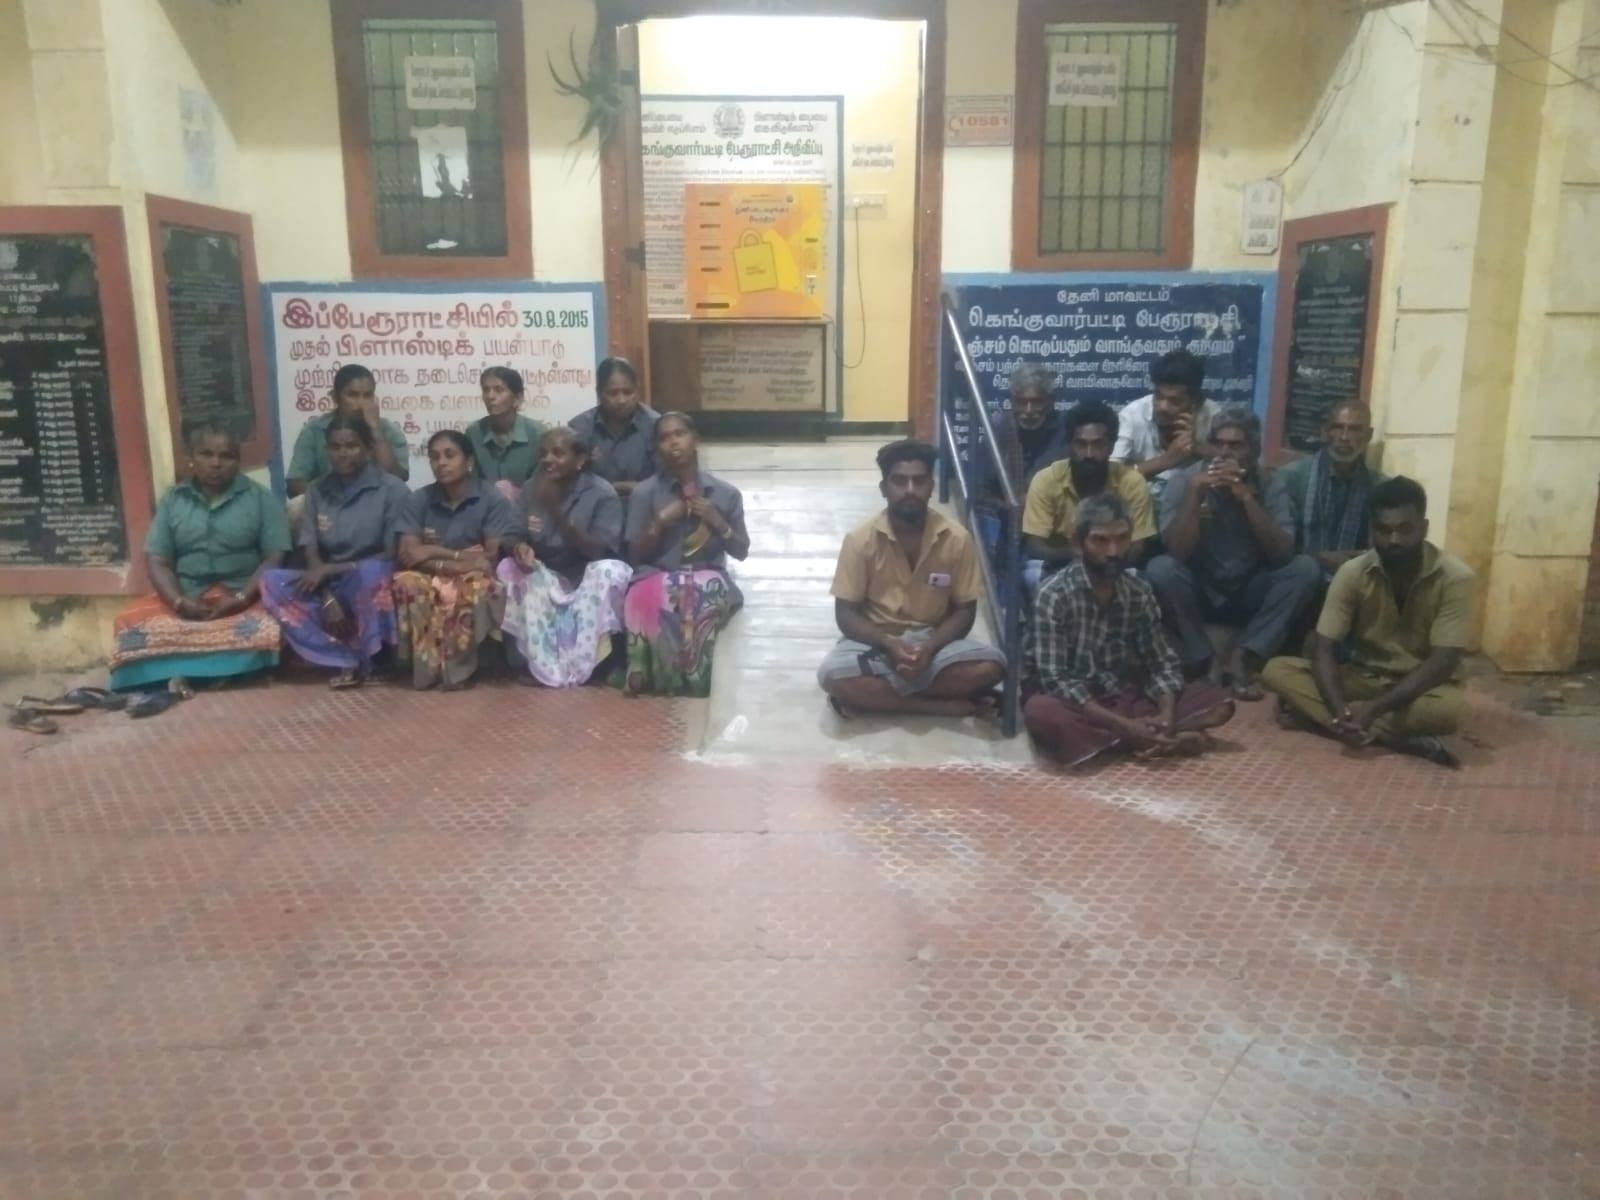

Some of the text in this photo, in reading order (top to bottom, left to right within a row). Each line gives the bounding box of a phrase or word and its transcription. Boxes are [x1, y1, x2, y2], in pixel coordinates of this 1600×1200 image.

[1057, 285, 1171, 304] தேனி மாவட்டம்
[969, 305, 1127, 332] கெங்குவார்பட்டி
[290, 334, 331, 361] முதல்
[336, 331, 475, 360] பிளாஸ்டிக்
[954, 334, 1007, 358] ஞ்சம்
